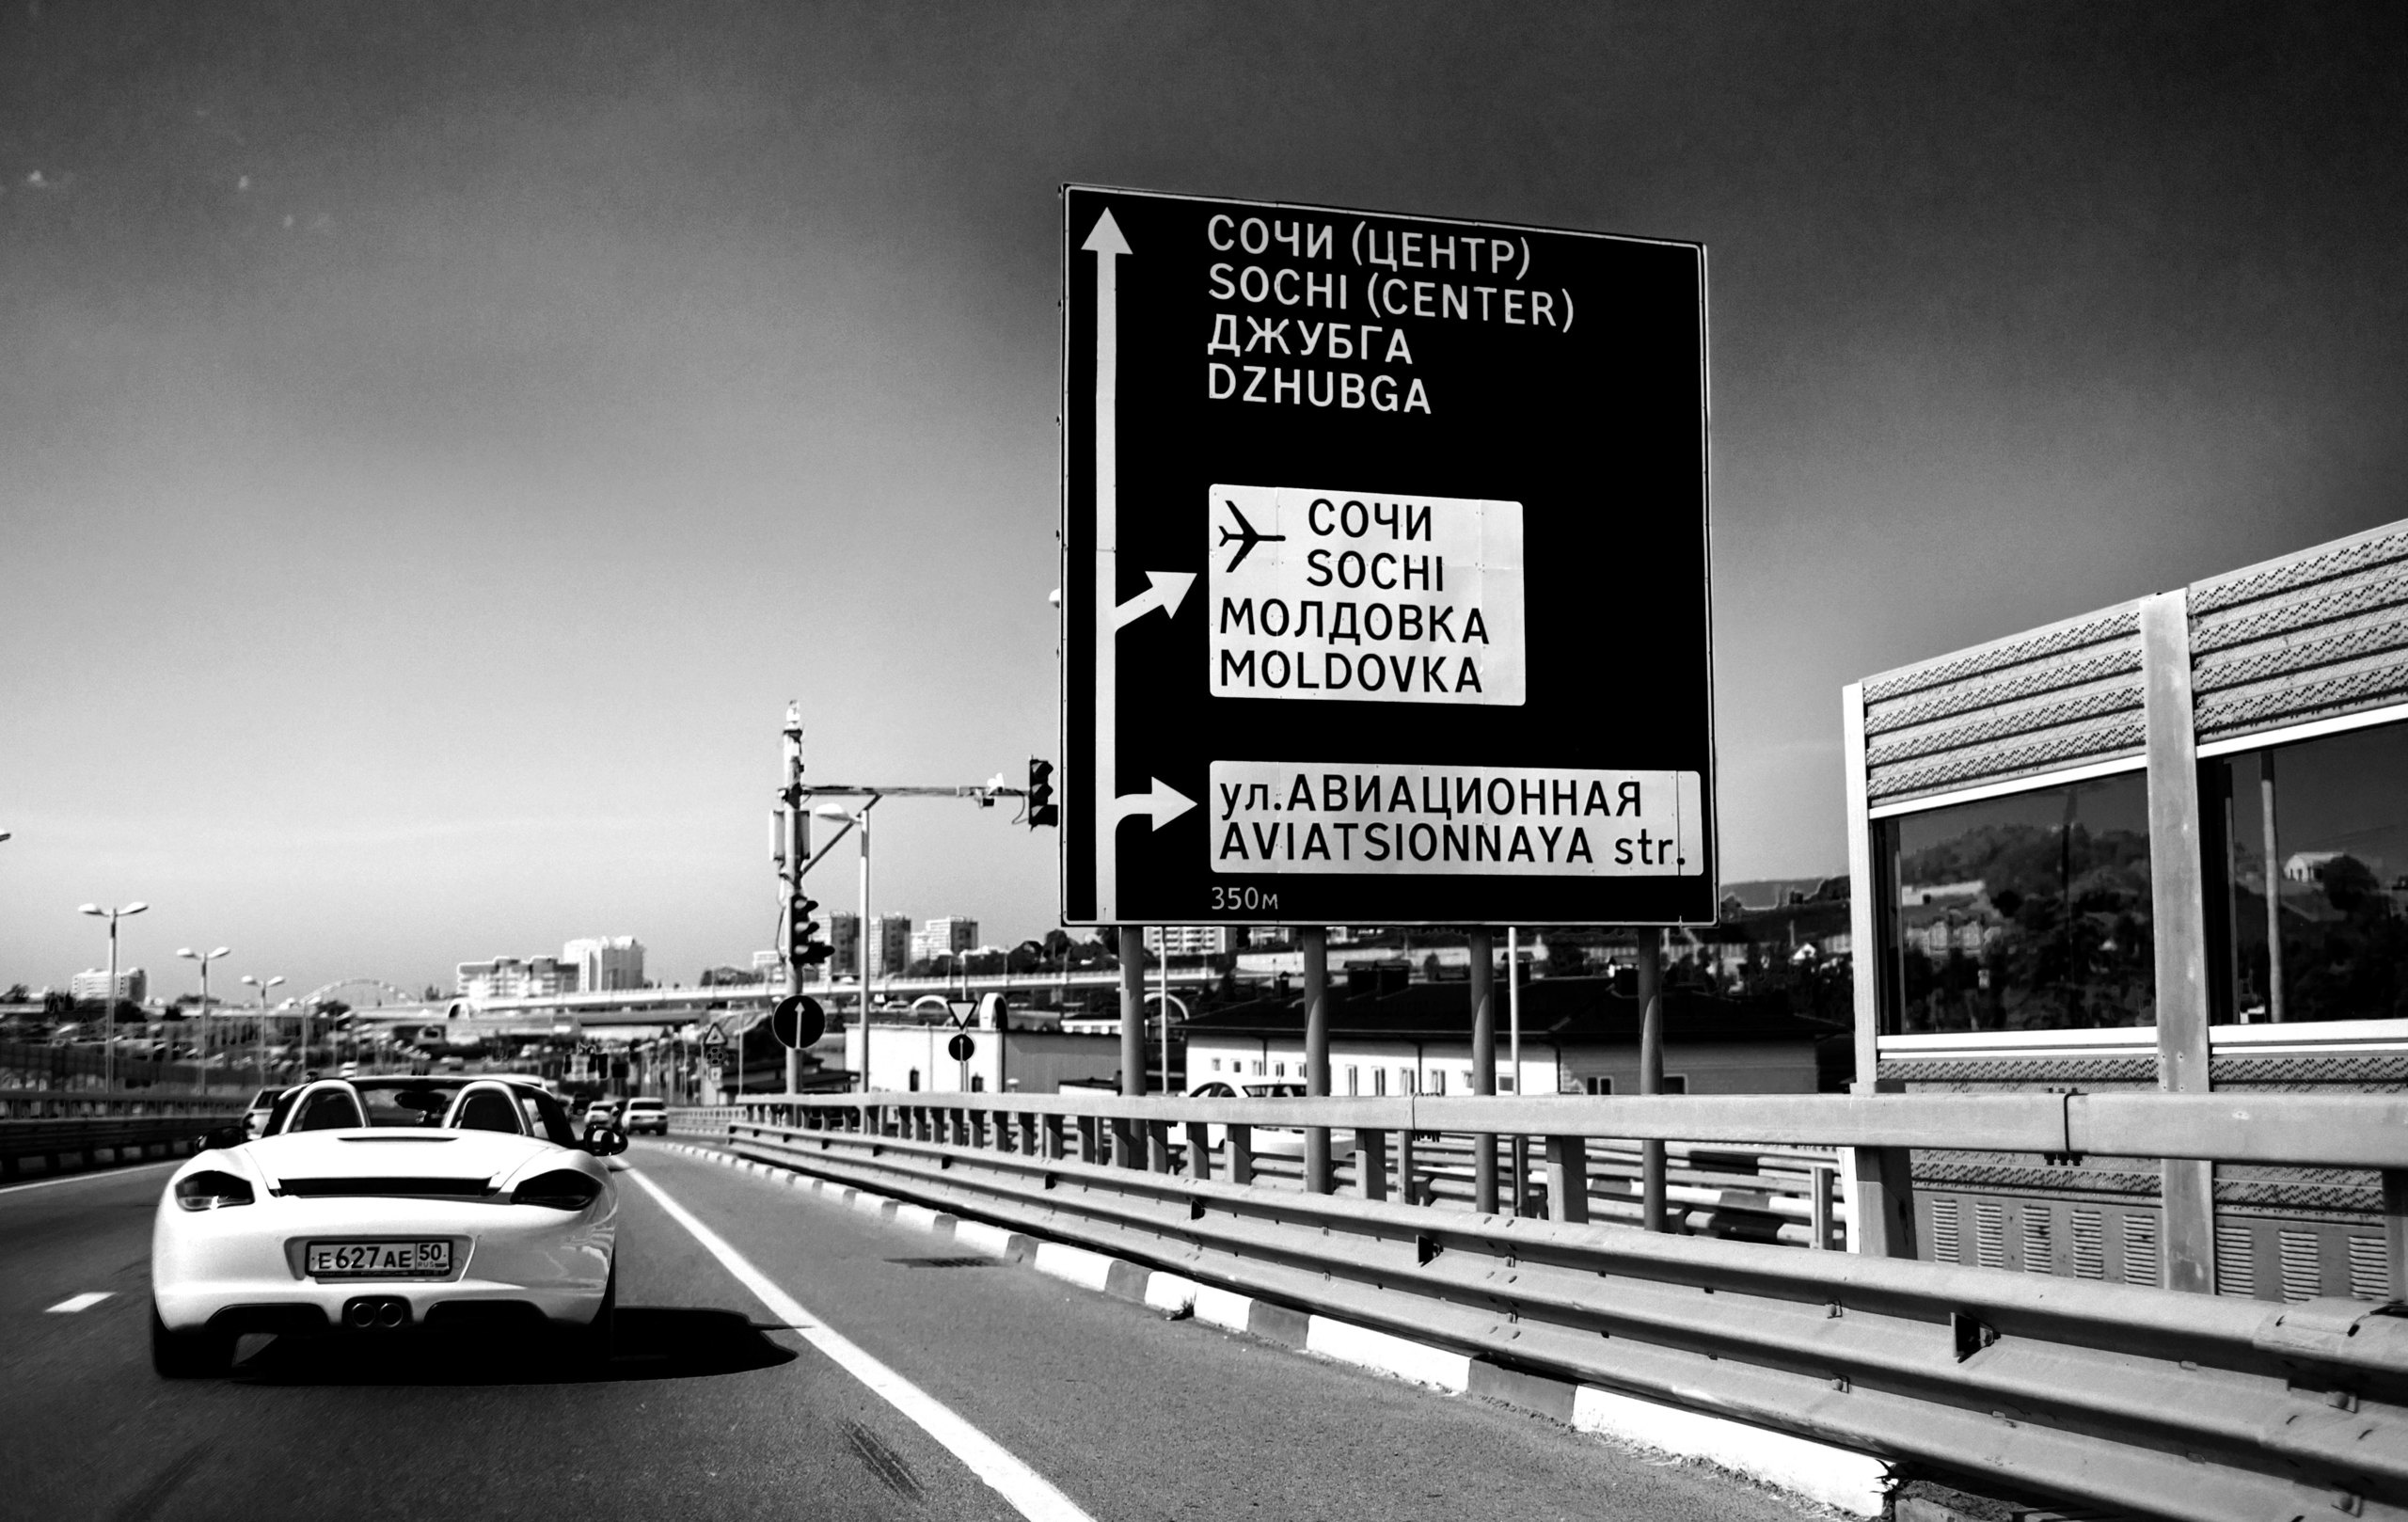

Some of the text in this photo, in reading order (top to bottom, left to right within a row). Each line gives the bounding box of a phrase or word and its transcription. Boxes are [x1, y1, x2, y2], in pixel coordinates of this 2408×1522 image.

[1207, 214, 1530, 281] СОЧИ (ЦЕНТР)
[1208, 262, 1574, 333] SOCHI (CENTER)
[1207, 313, 1413, 365] ДЖУБГА
[1209, 362, 1432, 415] DZHUBGA
[1308, 498, 1432, 542] СОЧИ
[1307, 548, 1443, 592] SOCHI
[1220, 596, 1490, 646] МОЛДОВКА
[1221, 649, 1482, 693] MOLDOVKA
[1219, 821, 1686, 865] AVIATSIONNAYA str.
[419, 1244, 442, 1261] 50
